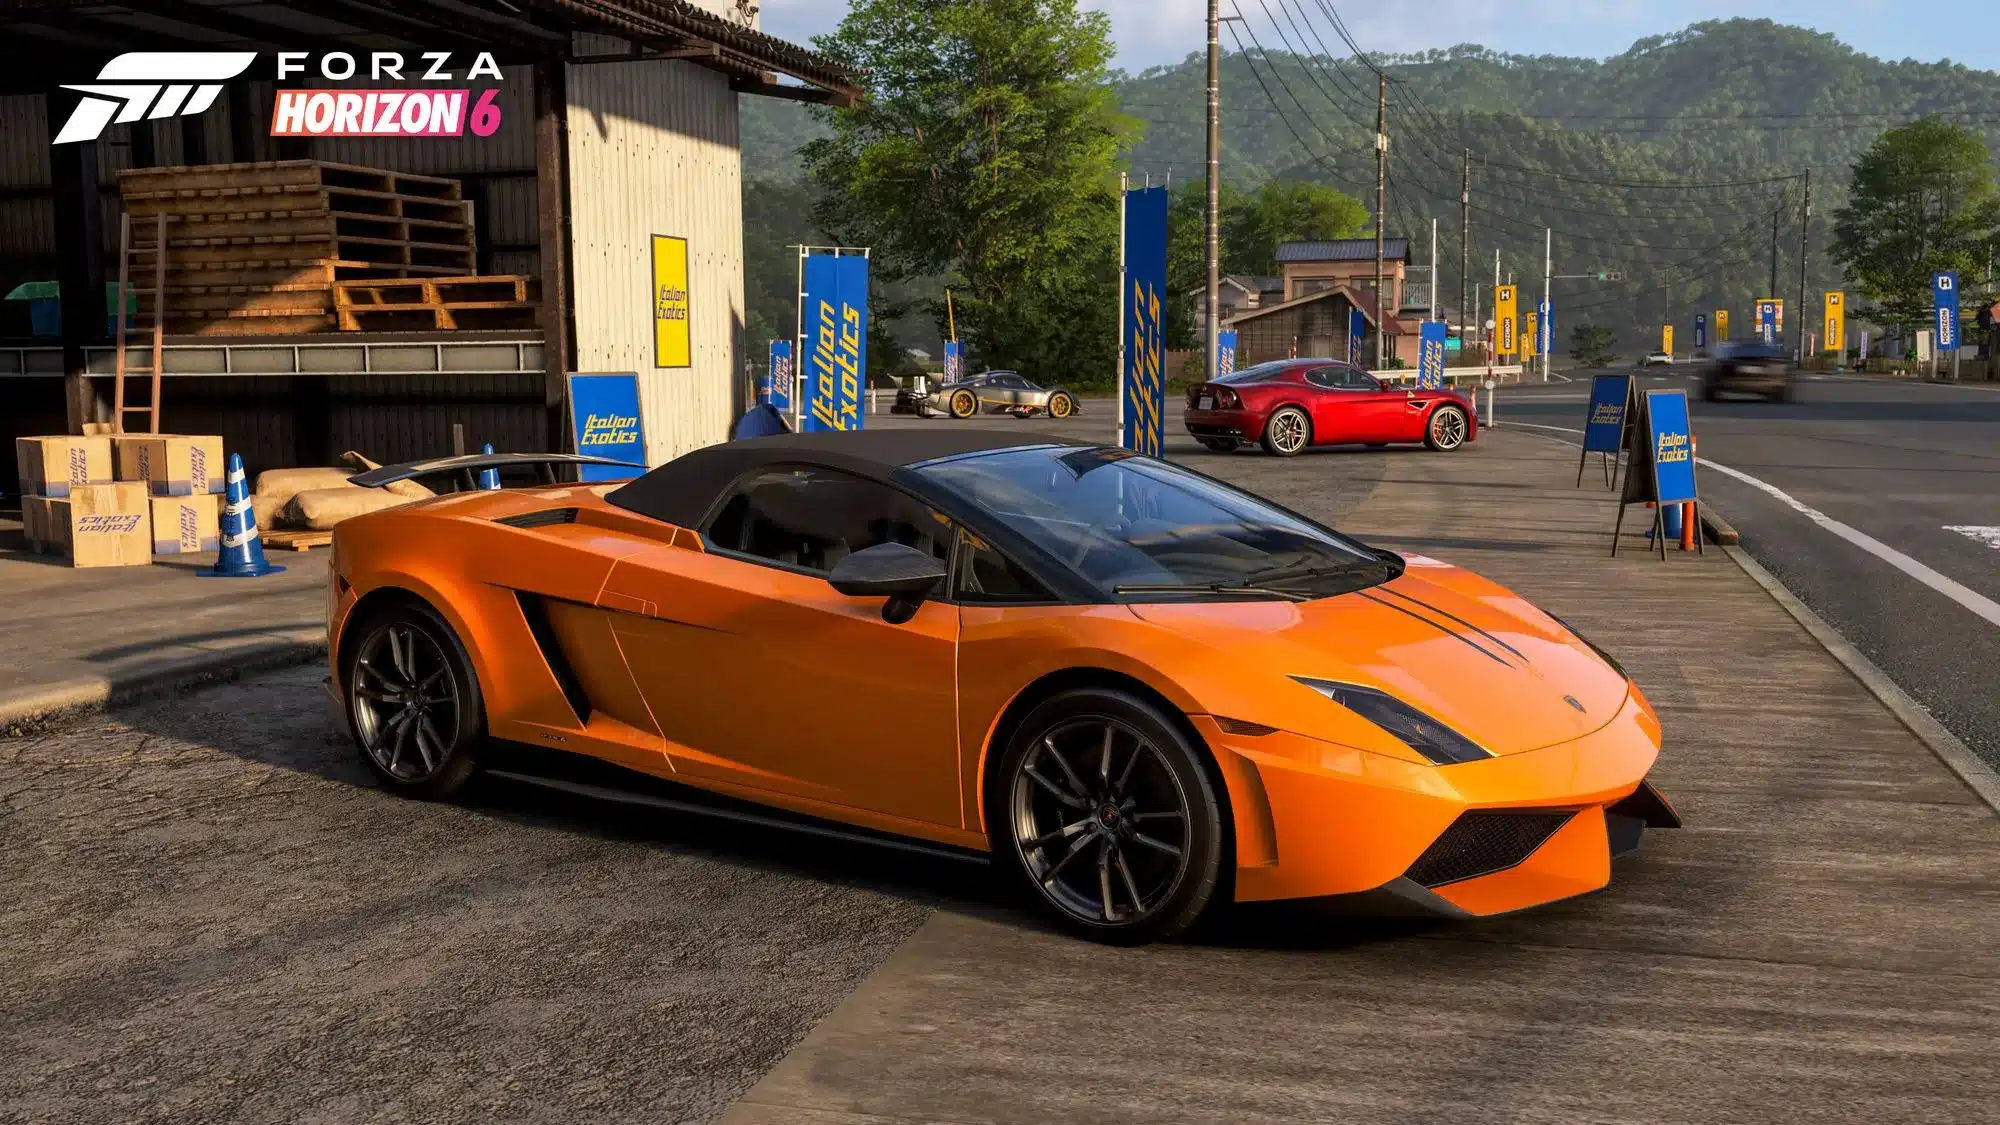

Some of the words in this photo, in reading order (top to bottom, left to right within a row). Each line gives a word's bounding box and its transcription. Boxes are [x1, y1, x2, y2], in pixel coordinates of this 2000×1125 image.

[660, 284, 686, 301] Italian
[656, 302, 686, 320] Exotics
[811, 299, 835, 429] Italian
[585, 414, 637, 429] Italian
[581, 428, 638, 445] Exotics
[1658, 432, 1688, 447] Italian
[1656, 447, 1689, 463] Exotics
[78, 448, 87, 485] xotics
[79, 514, 141, 524] Exotics
[79, 523, 136, 532] Italian
